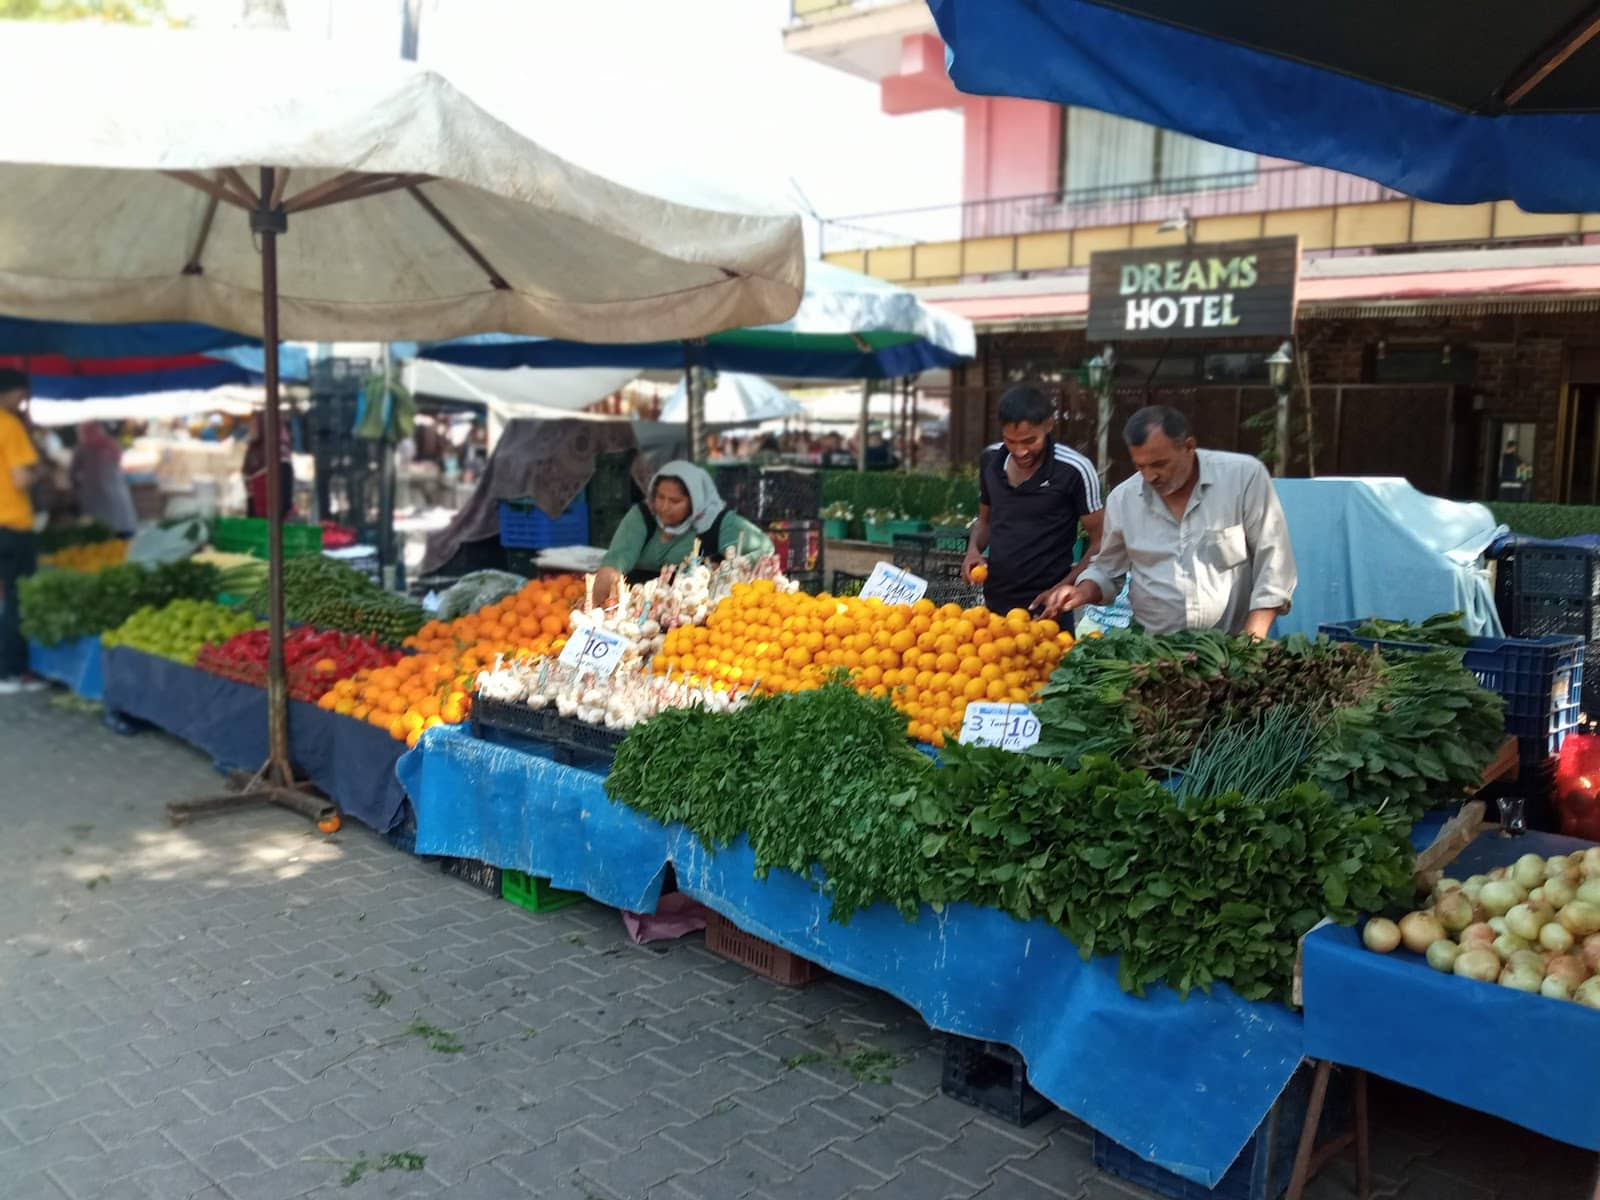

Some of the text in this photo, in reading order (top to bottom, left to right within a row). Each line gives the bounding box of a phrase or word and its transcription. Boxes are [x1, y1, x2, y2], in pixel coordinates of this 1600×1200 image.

[1120, 256, 1257, 294] DREAMS
[1125, 294, 1240, 329] HOTEL
[585, 640, 608, 658] 10
[969, 715, 983, 731] 3
[1008, 717, 1037, 737] 10
